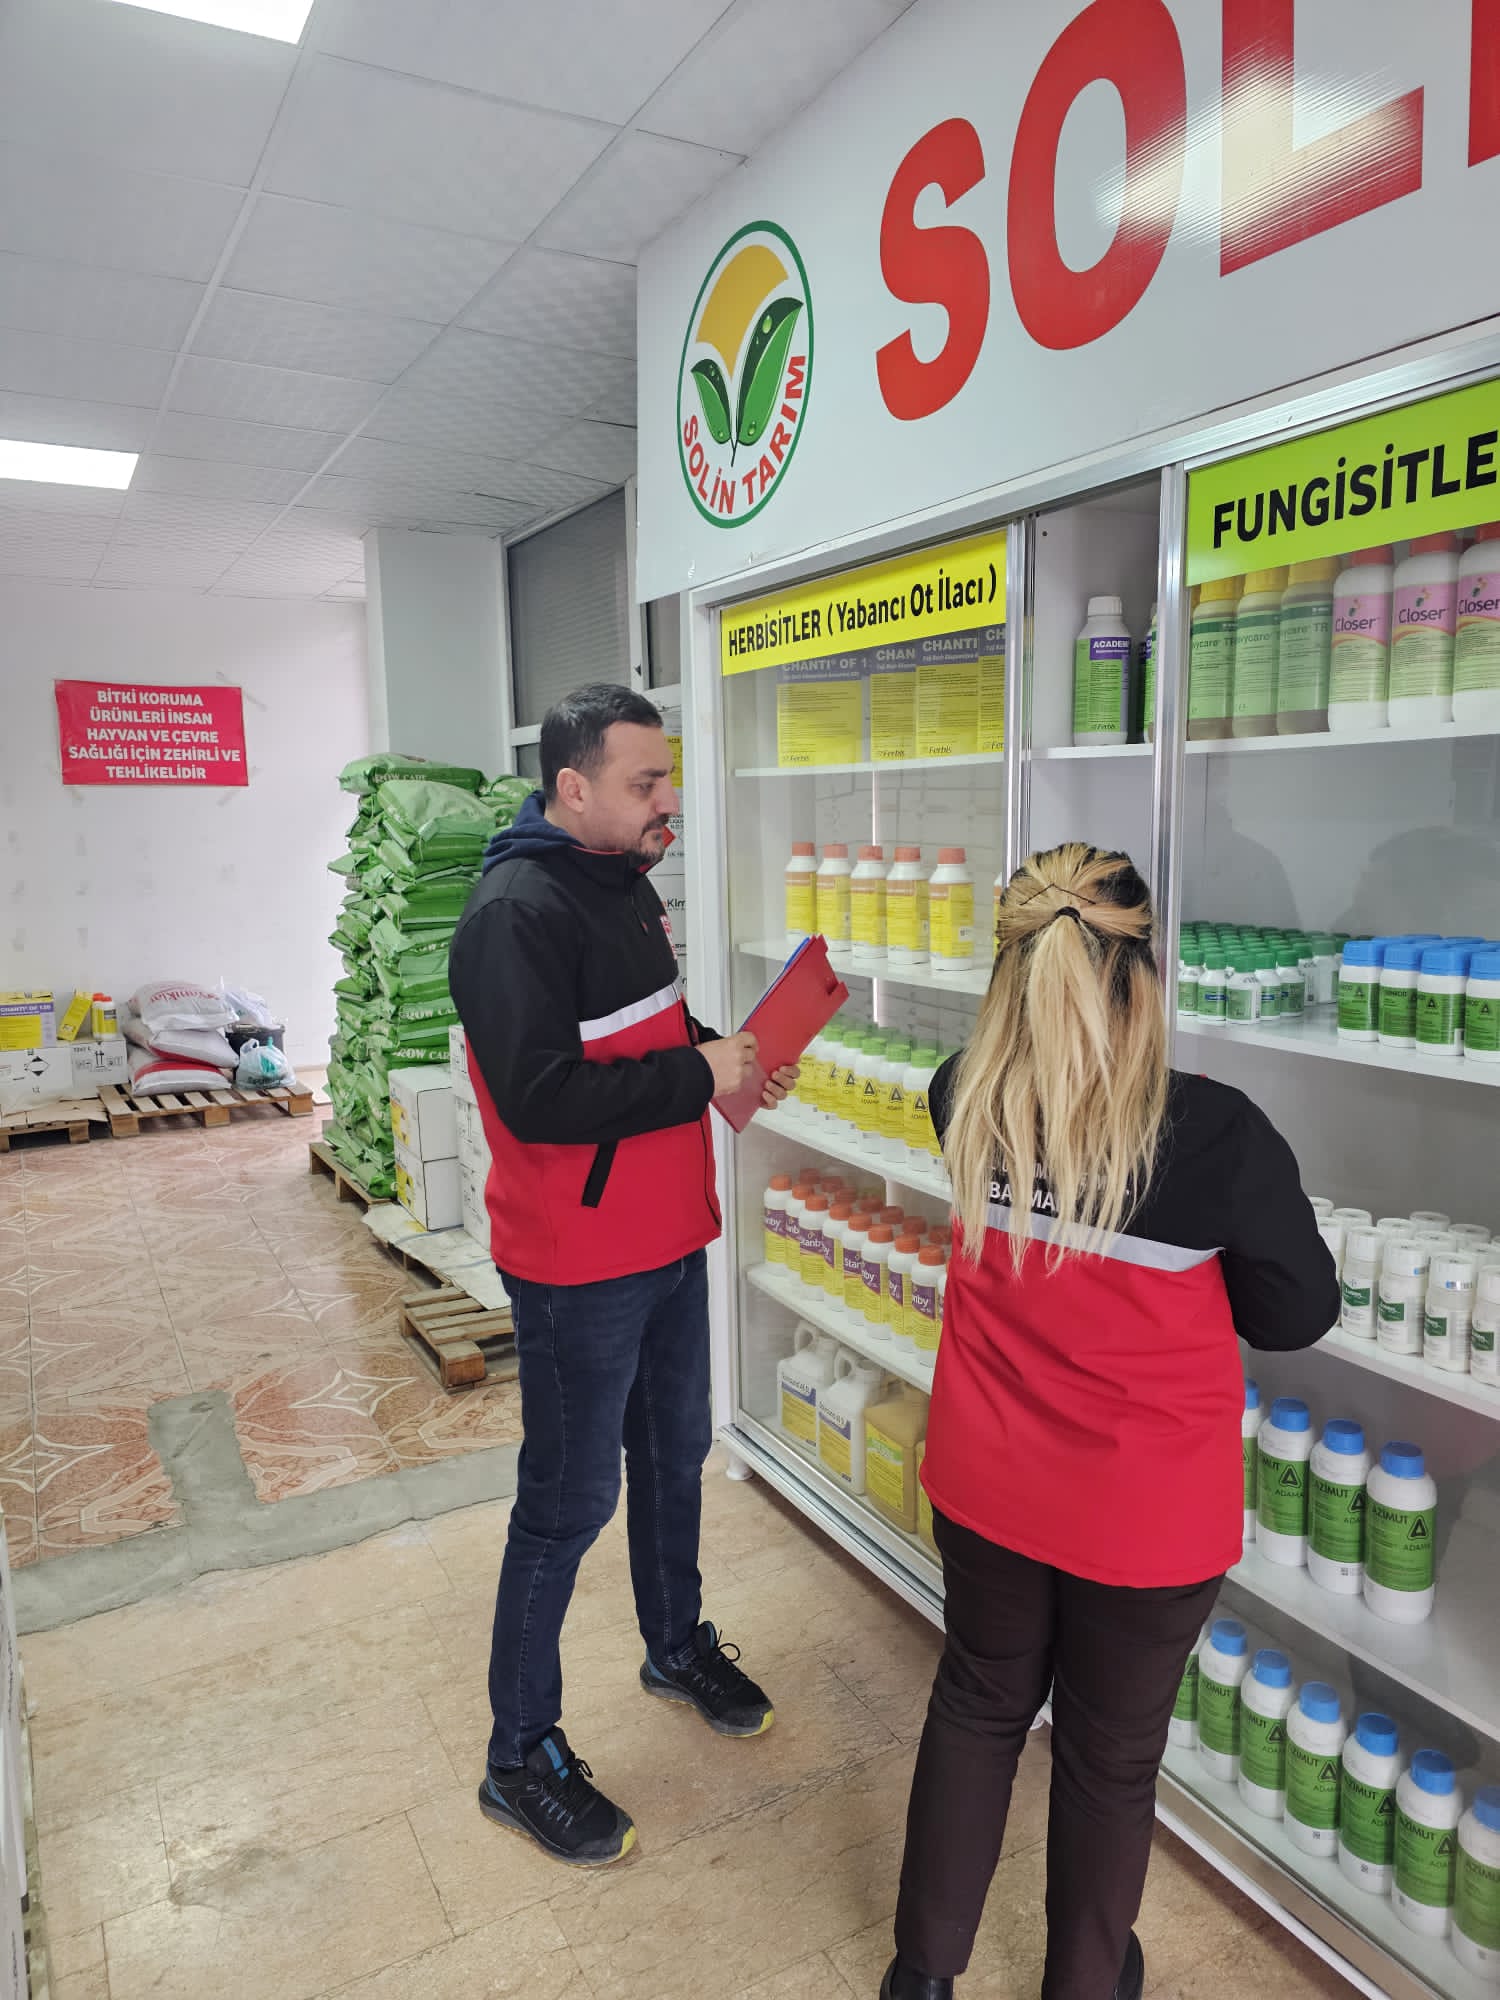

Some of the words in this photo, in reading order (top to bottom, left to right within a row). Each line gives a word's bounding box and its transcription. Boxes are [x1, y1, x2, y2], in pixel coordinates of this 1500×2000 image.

[684, 415, 736, 514] SOLİN
[742, 355, 806, 505] TARIM
[1213, 429, 1499, 549] FUNGİSİTLE
[728, 610, 821, 657] HERBİSİTLER
[910, 583, 933, 617] Ot
[1335, 616, 1376, 632] Closer
[1399, 607, 1446, 623] Closer
[96, 688, 136, 703] BİTKİ
[139, 691, 204, 706] KORUMA
[90, 706, 165, 724] ÜRÜNLERİ
[168, 709, 213, 725] İNSAN
[87, 727, 148, 742] HAYVAN
[150, 729, 170, 742] VE
[172, 730, 219, 745] ÇEVRE
[68, 743, 128, 760] SAĞLIĞI
[131, 746, 160, 763] İÇİN
[163, 746, 219, 762] ZEHİRLİ
[221, 749, 241, 762] VE
[105, 764, 206, 780] TEHLİKELİDİR
